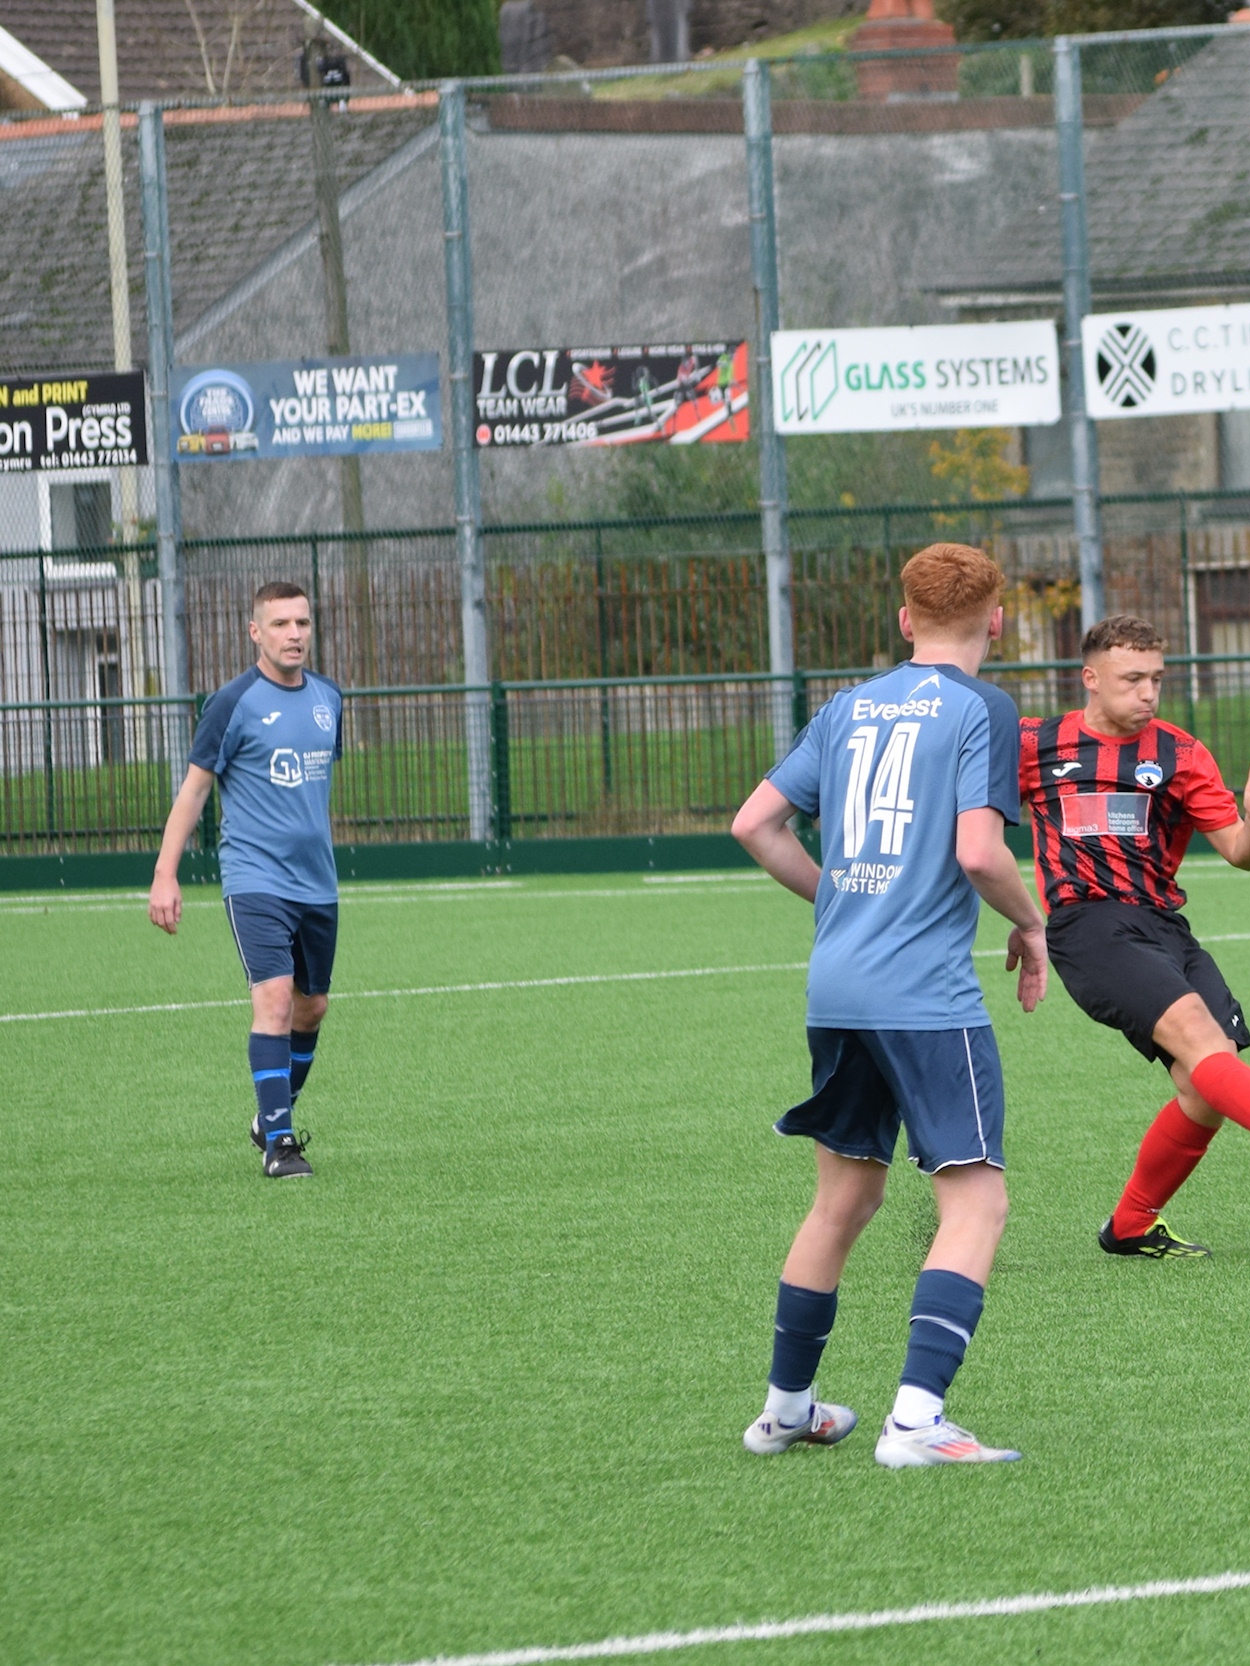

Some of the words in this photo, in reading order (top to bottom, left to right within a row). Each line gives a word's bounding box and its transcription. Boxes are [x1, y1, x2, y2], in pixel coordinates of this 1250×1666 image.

[293, 369, 328, 397] WE
[332, 365, 398, 394] WANT
[477, 350, 568, 399] LCL
[845, 361, 926, 391] GLASS
[935, 355, 1048, 388] SYSTEMS
[13, 383, 39, 407] and
[42, 381, 88, 404] PRINT
[269, 397, 332, 426] YOUR
[336, 390, 426, 423] PART-EX
[477, 398, 519, 419] TEAM
[521, 396, 567, 418] WEAR
[891, 401, 918, 418] UK'S
[920, 400, 971, 417] NUMBER
[974, 398, 998, 413] ONE
[0, 421, 33, 455] on
[46, 406, 132, 452] Press
[272, 426, 301, 445] AND
[303, 425, 324, 444] WE
[325, 424, 349, 443] PAY
[352, 422, 392, 440] MORE!
[494, 423, 539, 444] 01443
[543, 421, 598, 442] 771406
[61, 451, 95, 467] 01443
[843, 721, 921, 858] 14
[1066, 824, 1099, 834] sigma3
[850, 862, 904, 880] WINDOW
[841, 877, 890, 894] SYSTEMS
